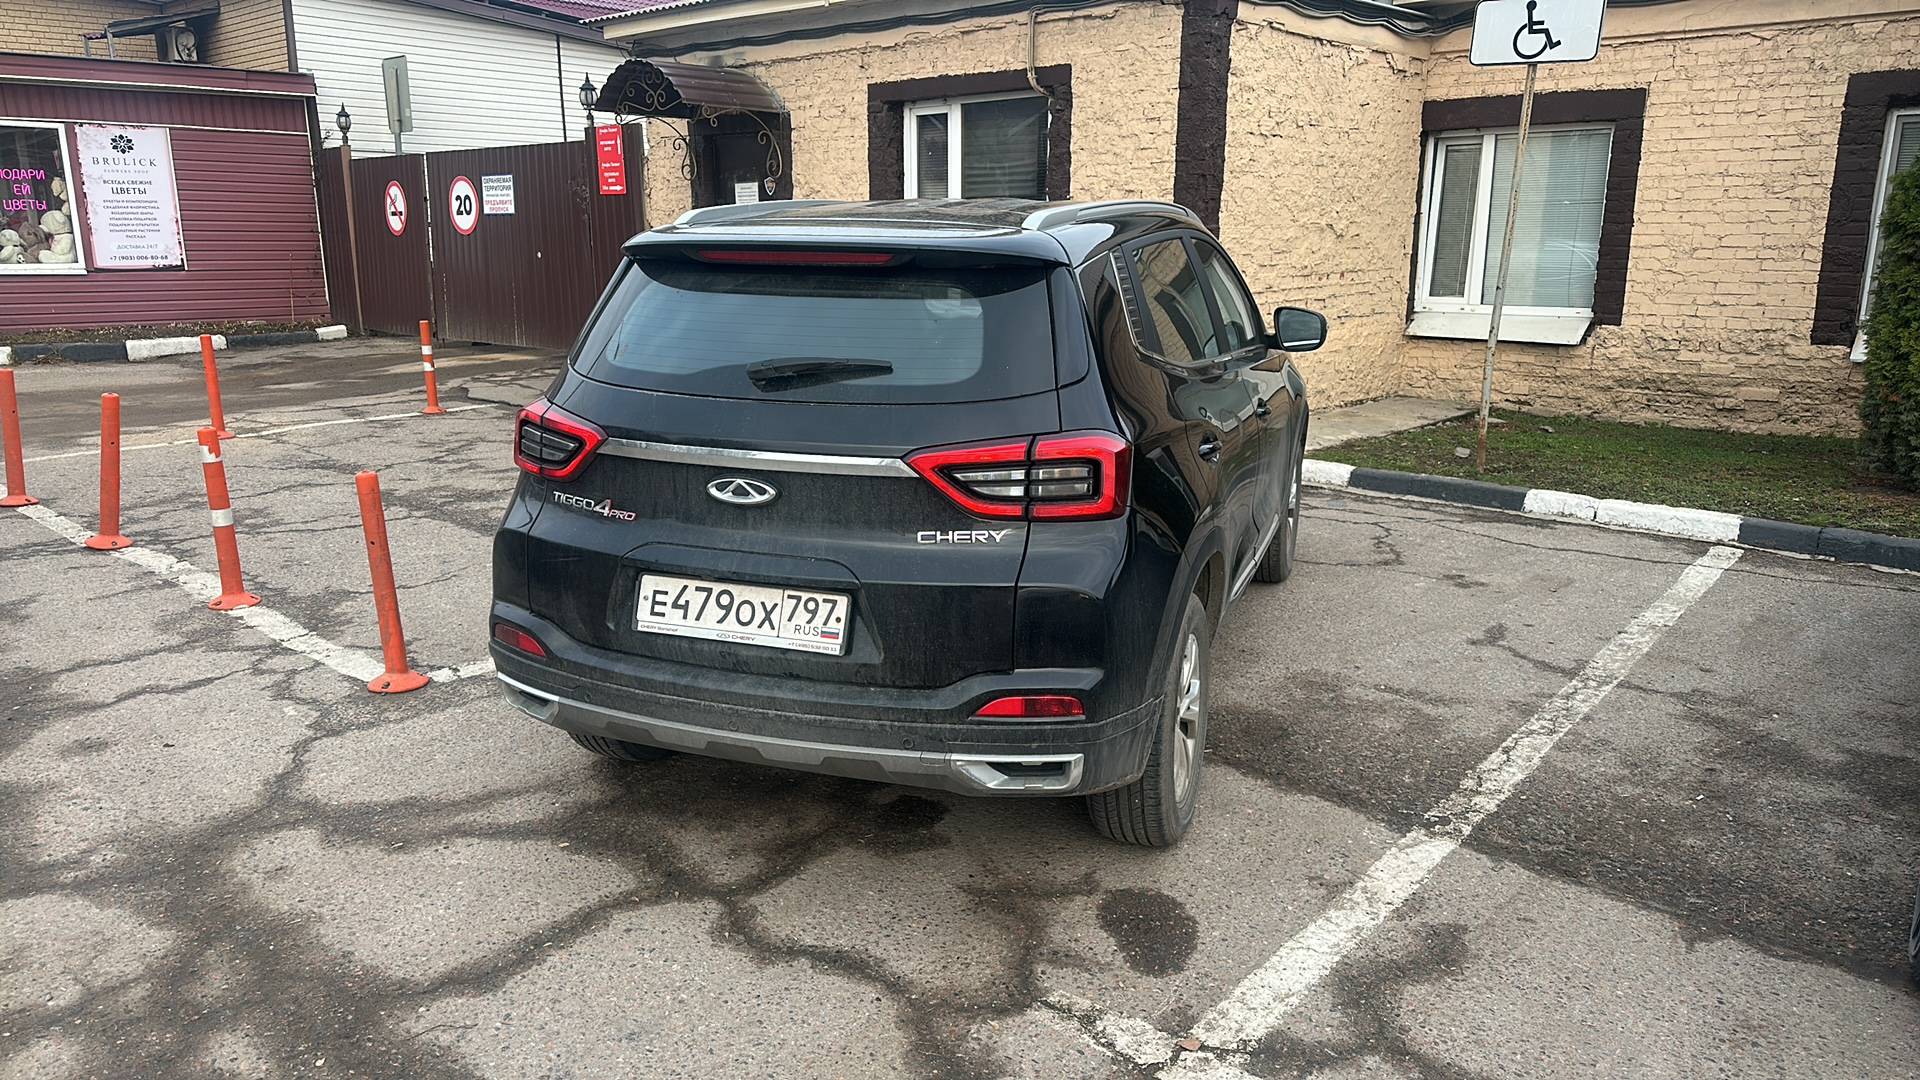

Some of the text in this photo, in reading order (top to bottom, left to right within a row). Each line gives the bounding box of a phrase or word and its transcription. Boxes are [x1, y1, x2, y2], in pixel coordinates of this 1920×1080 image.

[92, 156, 157, 167] BRULICK
[483, 176, 512, 185] ОХРАНЯЕМАЯ
[13, 182, 31, 196] ЕЙ
[111, 186, 147, 195] ЦВЕТЫ
[484, 184, 512, 192] ТЕРРИТОРИЯ
[3, 199, 47, 211] ЦВЕТЫ
[455, 194, 472, 216] 20
[553, 491, 595, 511] TIGGO
[608, 509, 637, 521] PRO
[917, 528, 1015, 544] CHERY
[649, 584, 838, 631] Е479ОХ 797
[793, 624, 820, 637] RUS
